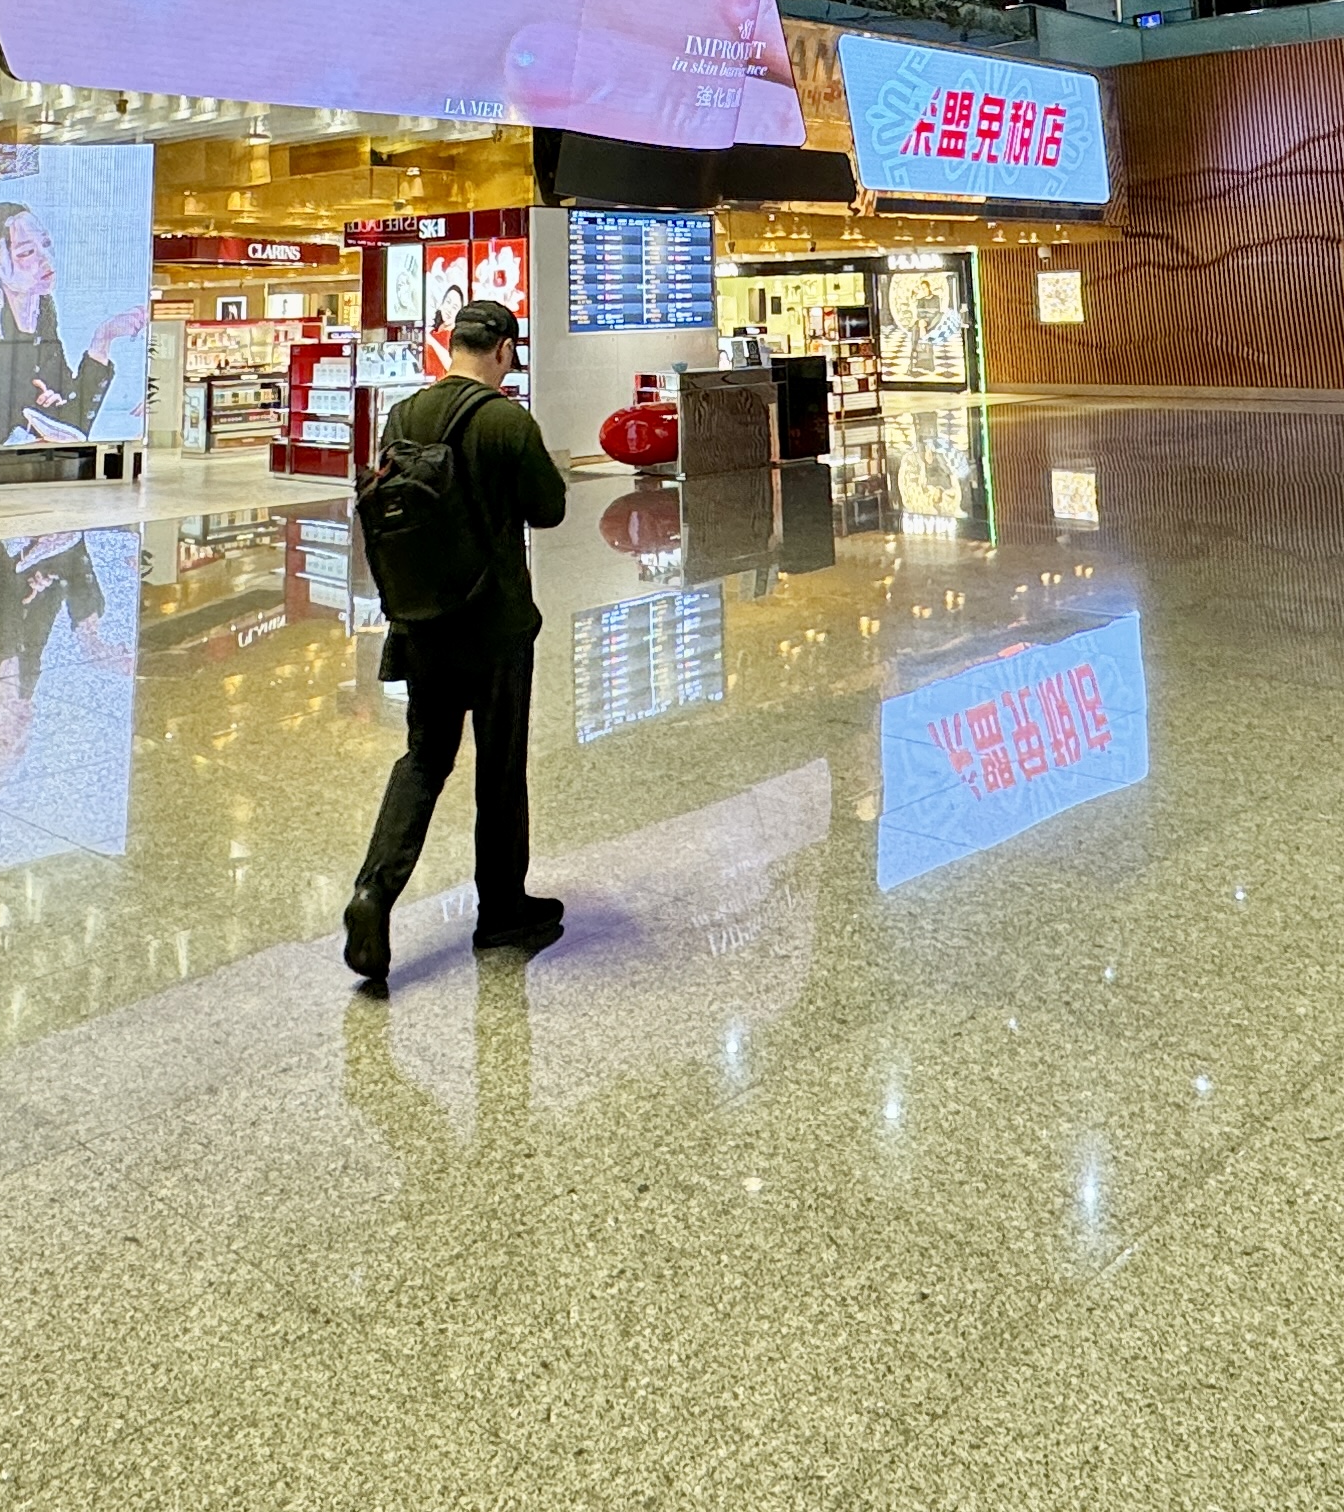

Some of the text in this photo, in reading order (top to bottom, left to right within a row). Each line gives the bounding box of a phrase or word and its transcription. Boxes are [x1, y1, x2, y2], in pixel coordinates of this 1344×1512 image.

[671, 56, 689, 73] in
[690, 58, 719, 76] skin
[444, 97, 504, 119] LA MER
[247, 243, 302, 261] CLARINS
